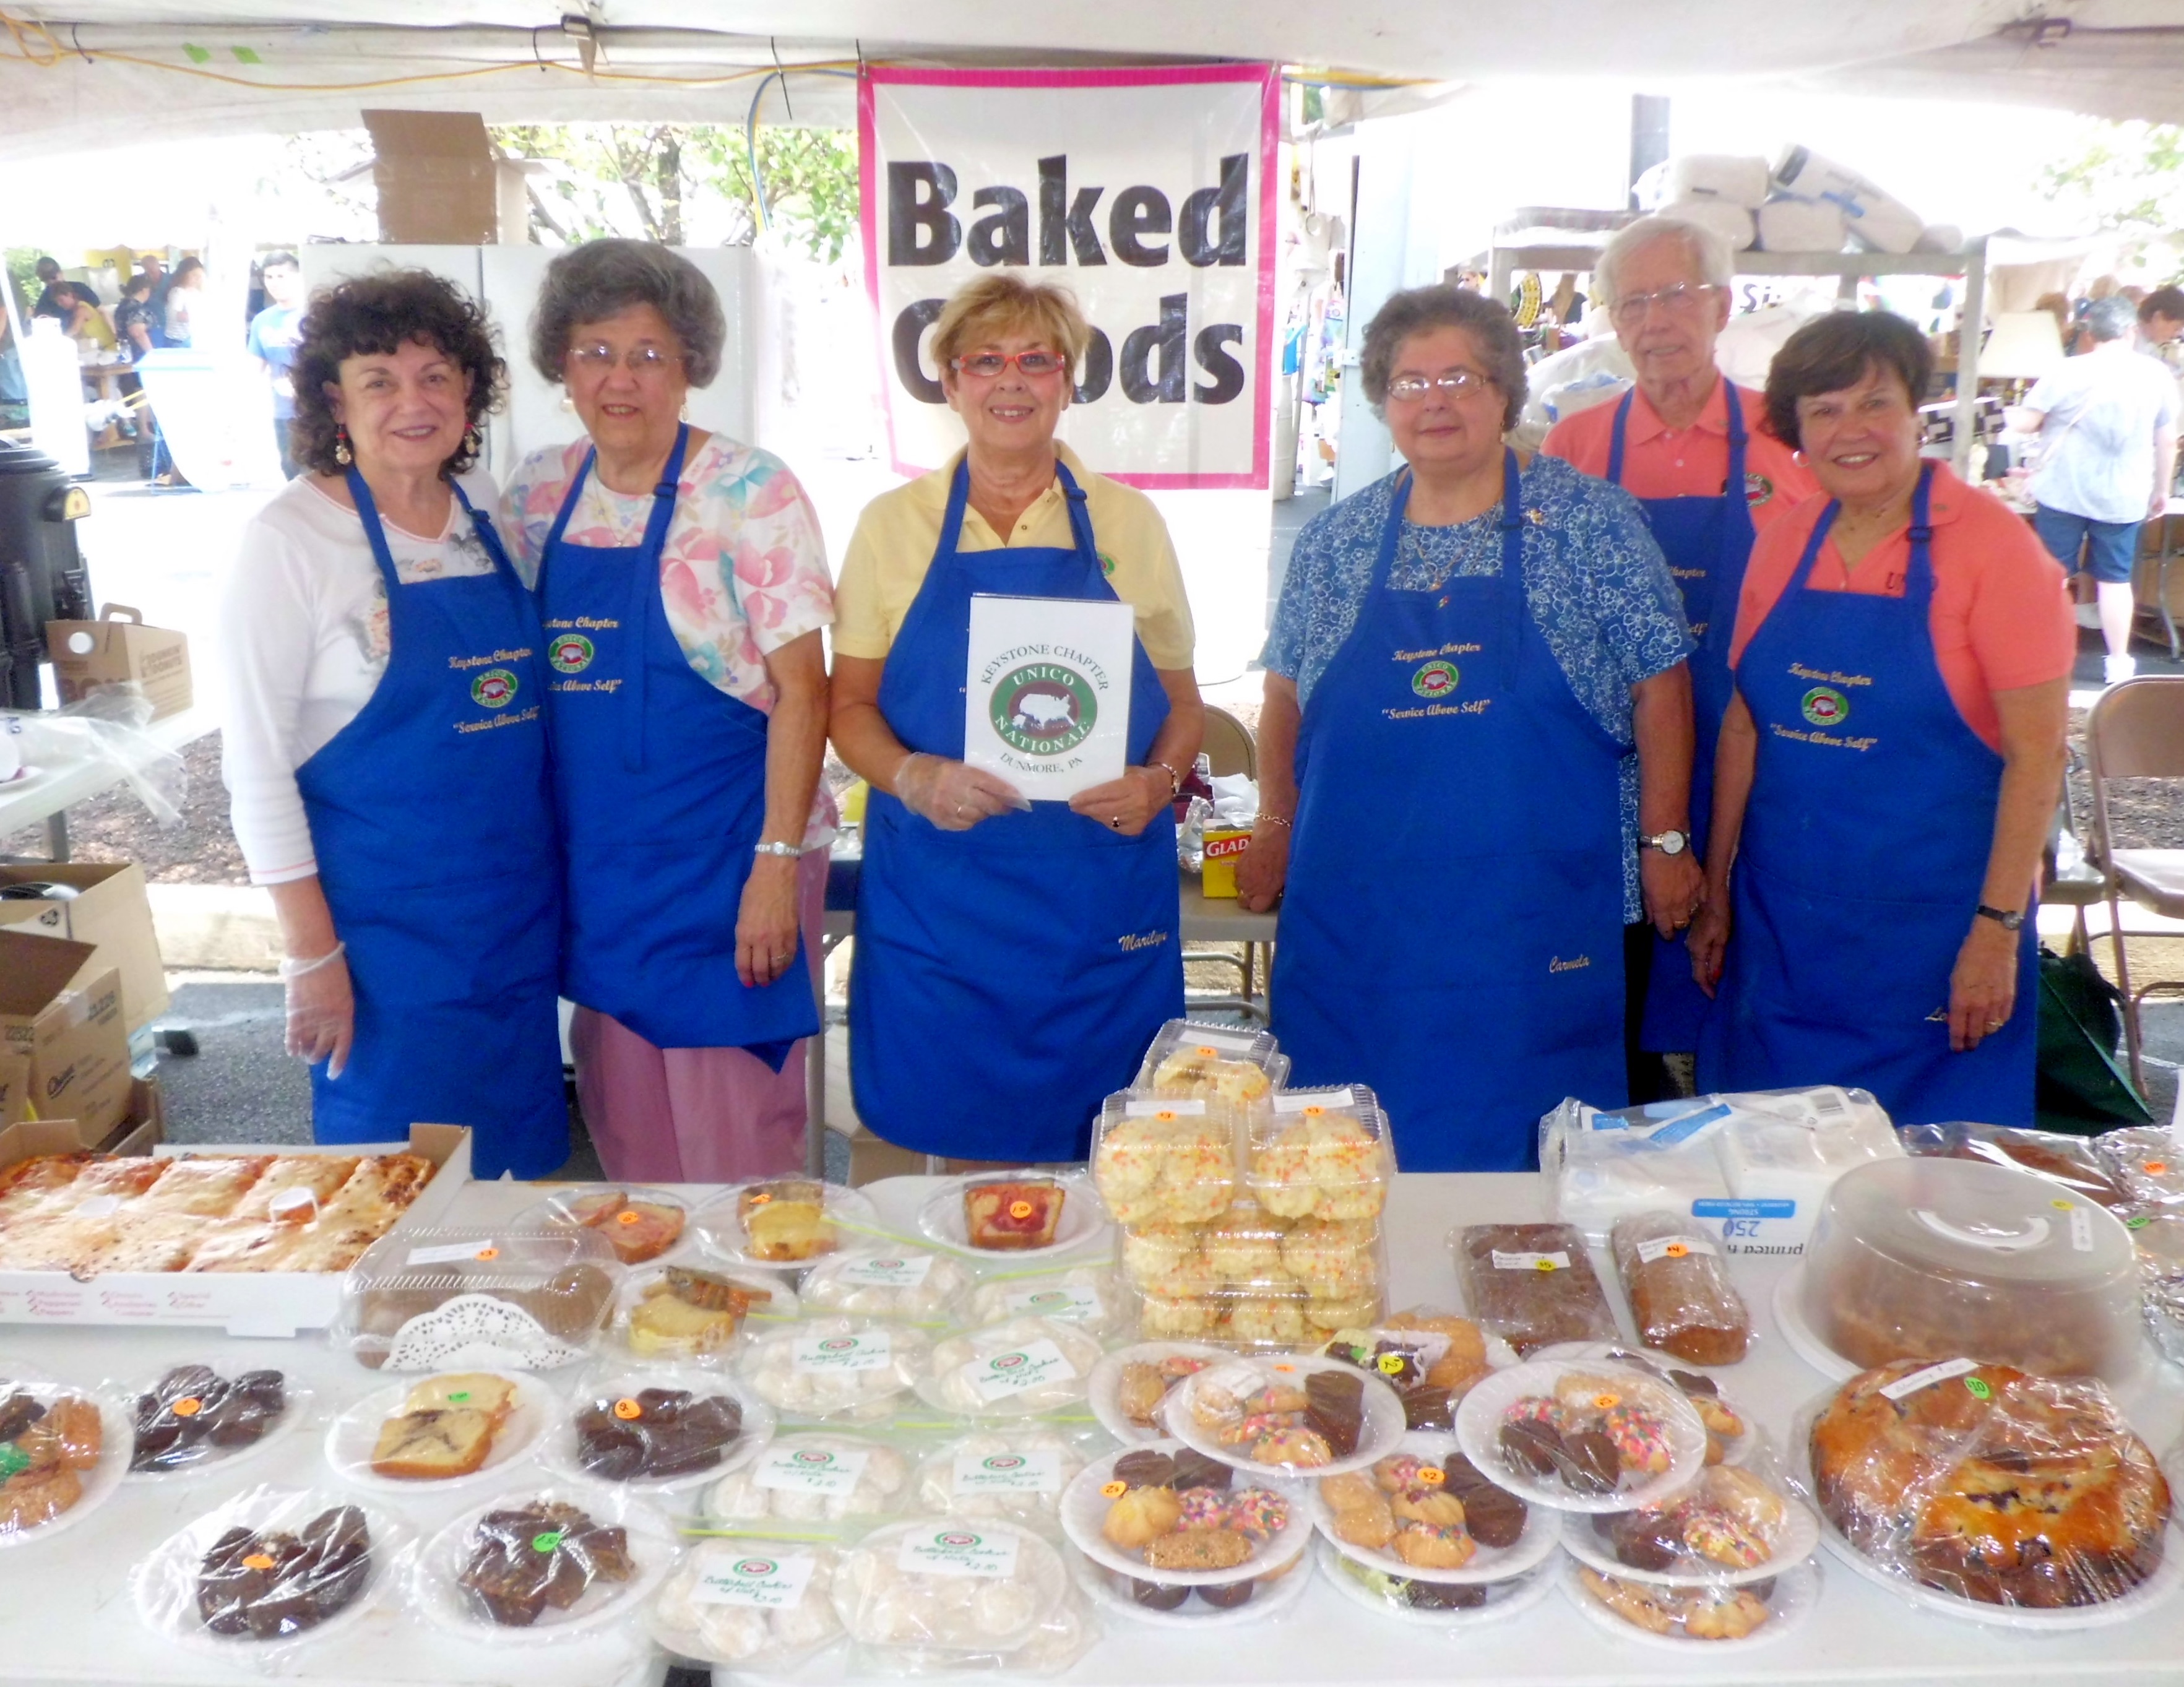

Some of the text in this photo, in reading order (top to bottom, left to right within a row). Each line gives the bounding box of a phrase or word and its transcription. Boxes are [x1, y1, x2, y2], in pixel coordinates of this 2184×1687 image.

[888, 153, 1248, 266] Baked
[892, 293, 1245, 405] Gods
[575, 616, 618, 631] Chapter
[1392, 642, 1482, 663] Keystone Chapter
[981, 644, 1109, 690] KEYSTONE CHAPTER
[1013, 666, 1075, 687] UNICO
[563, 680, 592, 691] Above
[1427, 704, 1459, 717] Above
[994, 715, 1090, 753] NATIONAL
[1000, 753, 1083, 774] DUNMORE, PA
[1206, 839, 1249, 857] GLAD
[1118, 930, 1168, 952] Marilyn
